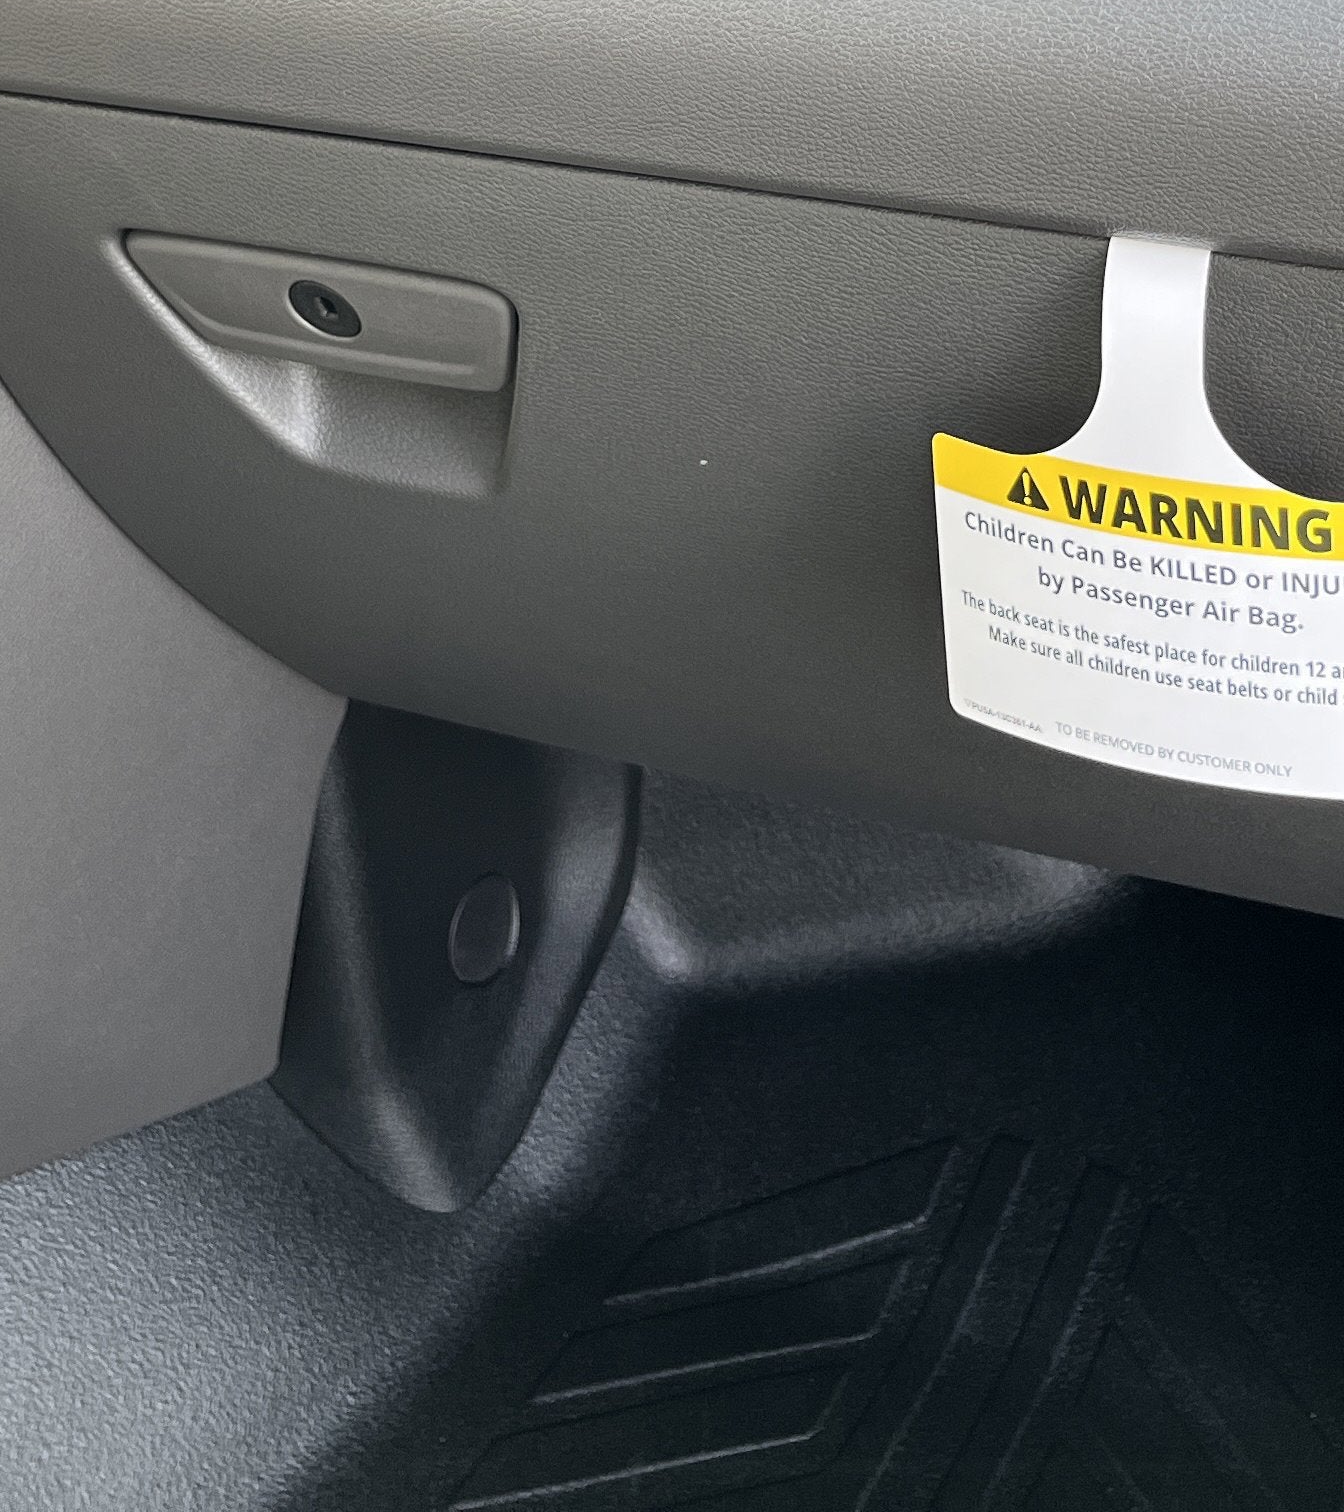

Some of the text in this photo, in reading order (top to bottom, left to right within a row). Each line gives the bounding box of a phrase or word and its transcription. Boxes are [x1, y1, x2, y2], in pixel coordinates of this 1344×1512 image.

[964, 510, 1055, 554] Children
[1061, 539, 1105, 566] Can
[1113, 549, 1142, 572] Be
[1150, 555, 1237, 586] KILLED
[1245, 572, 1274, 591] or
[1058, 474, 1334, 554] WARNING
[961, 589, 985, 612] The
[988, 598, 1022, 624] back
[1024, 613, 1055, 634] seat
[1058, 619, 1070, 638] is
[1074, 626, 1099, 645] the
[1103, 634, 1151, 657] safest
[1154, 642, 1197, 664] place
[1202, 648, 1227, 668] for
[1231, 652, 1301, 676] children
[1305, 660, 1327, 679] 12
[1037, 565, 1304, 634] by Passenger Air Bag.
[988, 624, 1027, 651] Make
[1030, 641, 1062, 661] sure
[1065, 648, 1084, 668] all
[1087, 653, 1151, 682] children
[1154, 670, 1183, 689] use
[1187, 675, 1224, 695] seat
[1227, 677, 1269, 700] belts
[1273, 687, 1294, 702] or
[1296, 686, 1338, 707] child
[1055, 721, 1294, 778] TO BE REMOVED BY CUSTOMER ONLY
